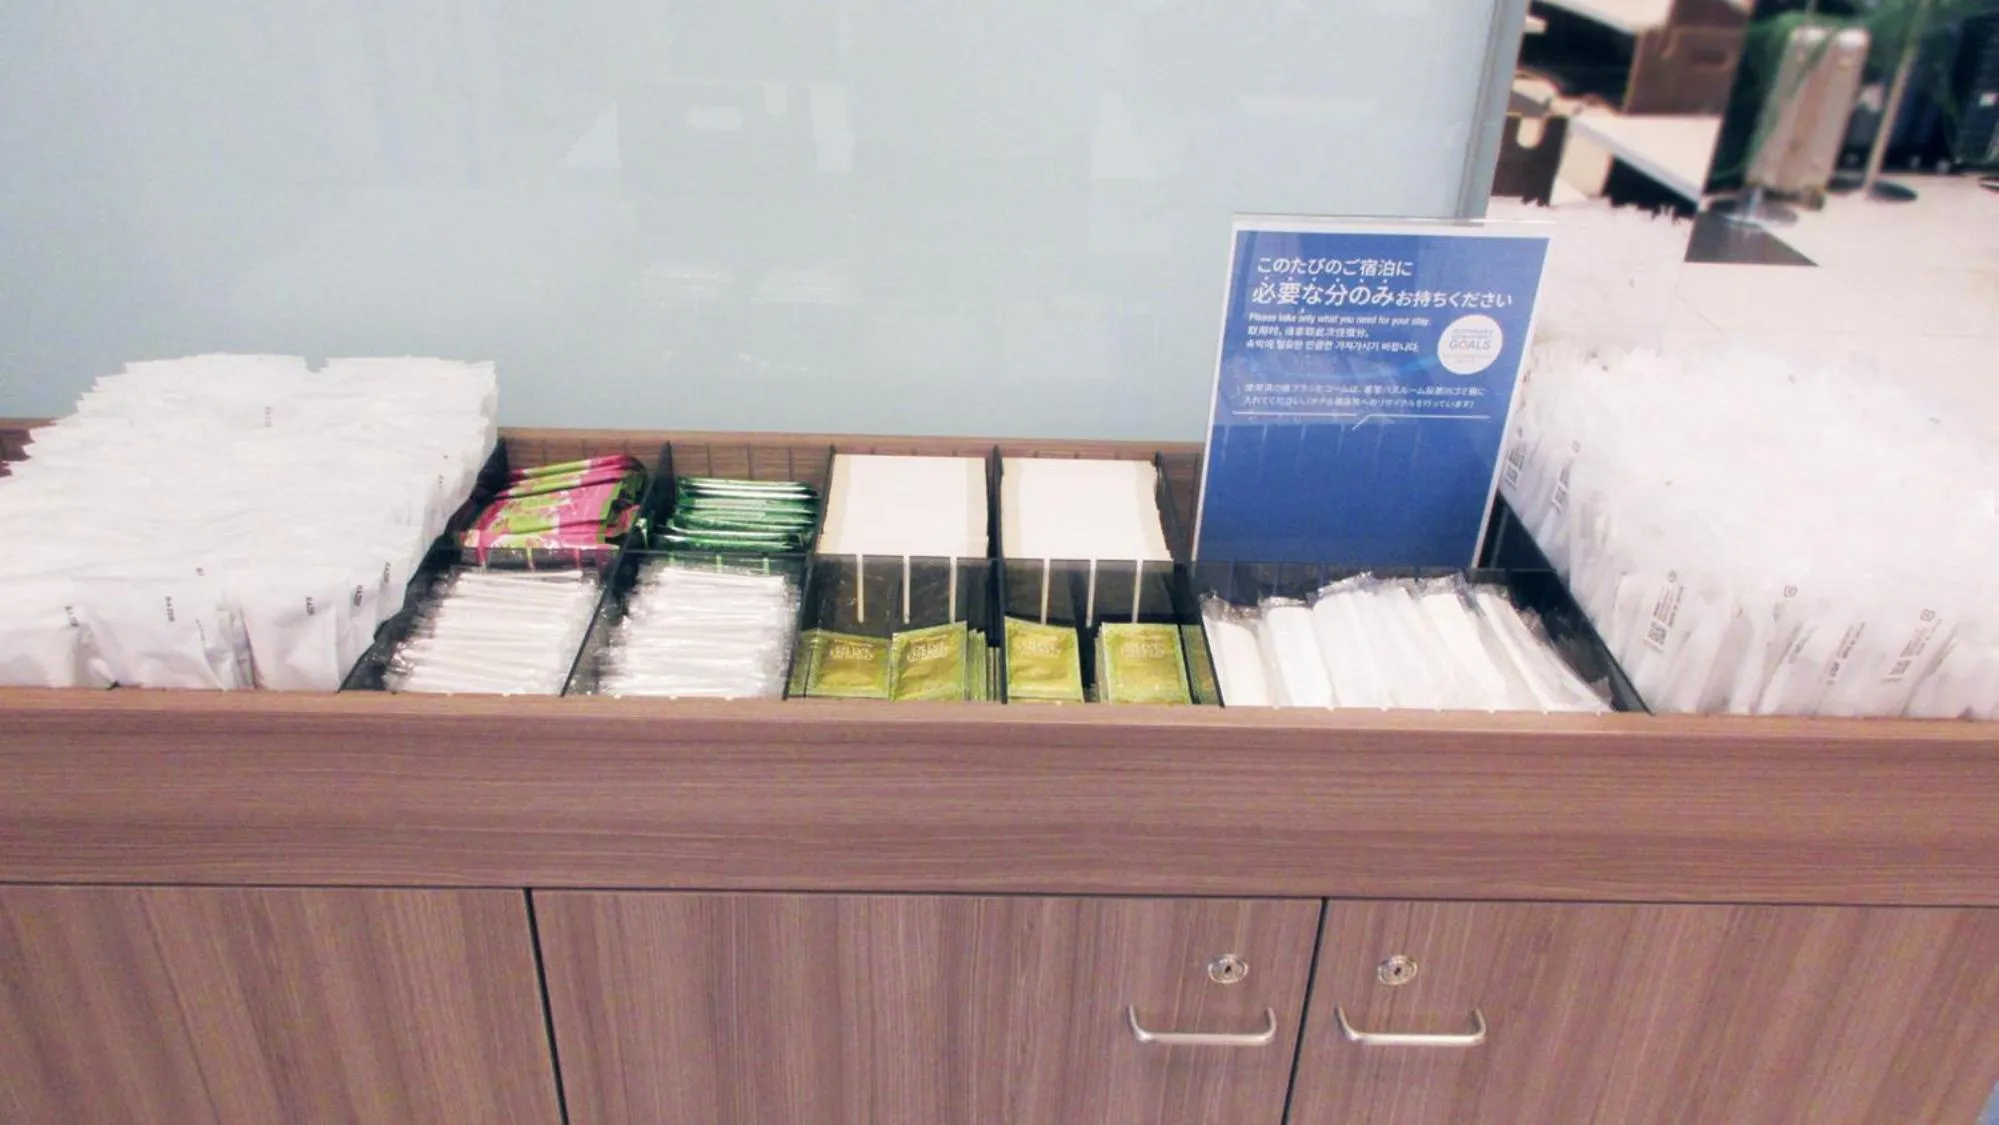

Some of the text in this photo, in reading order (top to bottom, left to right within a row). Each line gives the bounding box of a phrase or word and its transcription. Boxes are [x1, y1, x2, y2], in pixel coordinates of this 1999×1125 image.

[1257, 257, 1413, 277] このたびのご宿泊に
[1251, 281, 1512, 308] 必要な分のみお持ちください
[1449, 339, 1492, 350] GOALS
